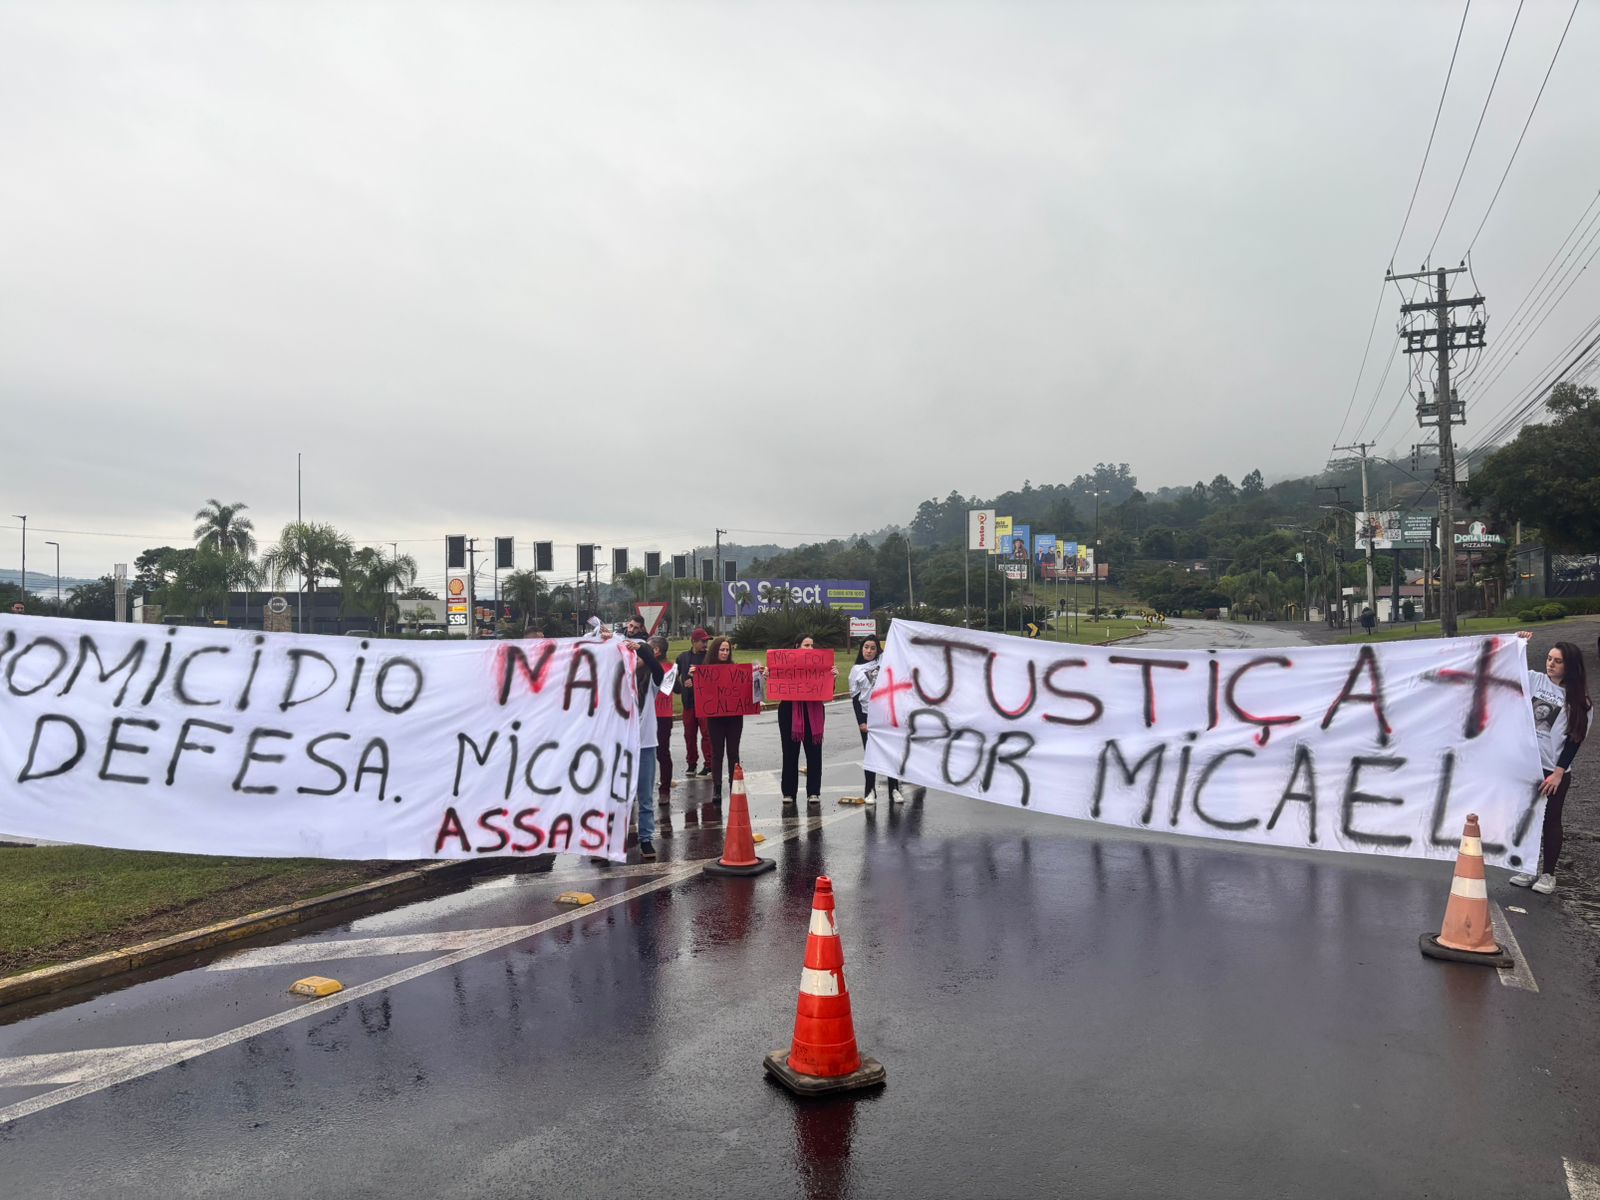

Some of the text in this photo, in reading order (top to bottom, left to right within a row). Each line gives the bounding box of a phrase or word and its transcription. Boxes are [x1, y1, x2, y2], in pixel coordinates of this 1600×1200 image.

[757, 581, 822, 604] Slect
[0, 628, 423, 714] OMICIDIO
[804, 653, 824, 665] FOI
[911, 636, 1391, 746] JUSTIÇA
[18, 714, 402, 803] DEFESA.
[900, 708, 1034, 807] POR
